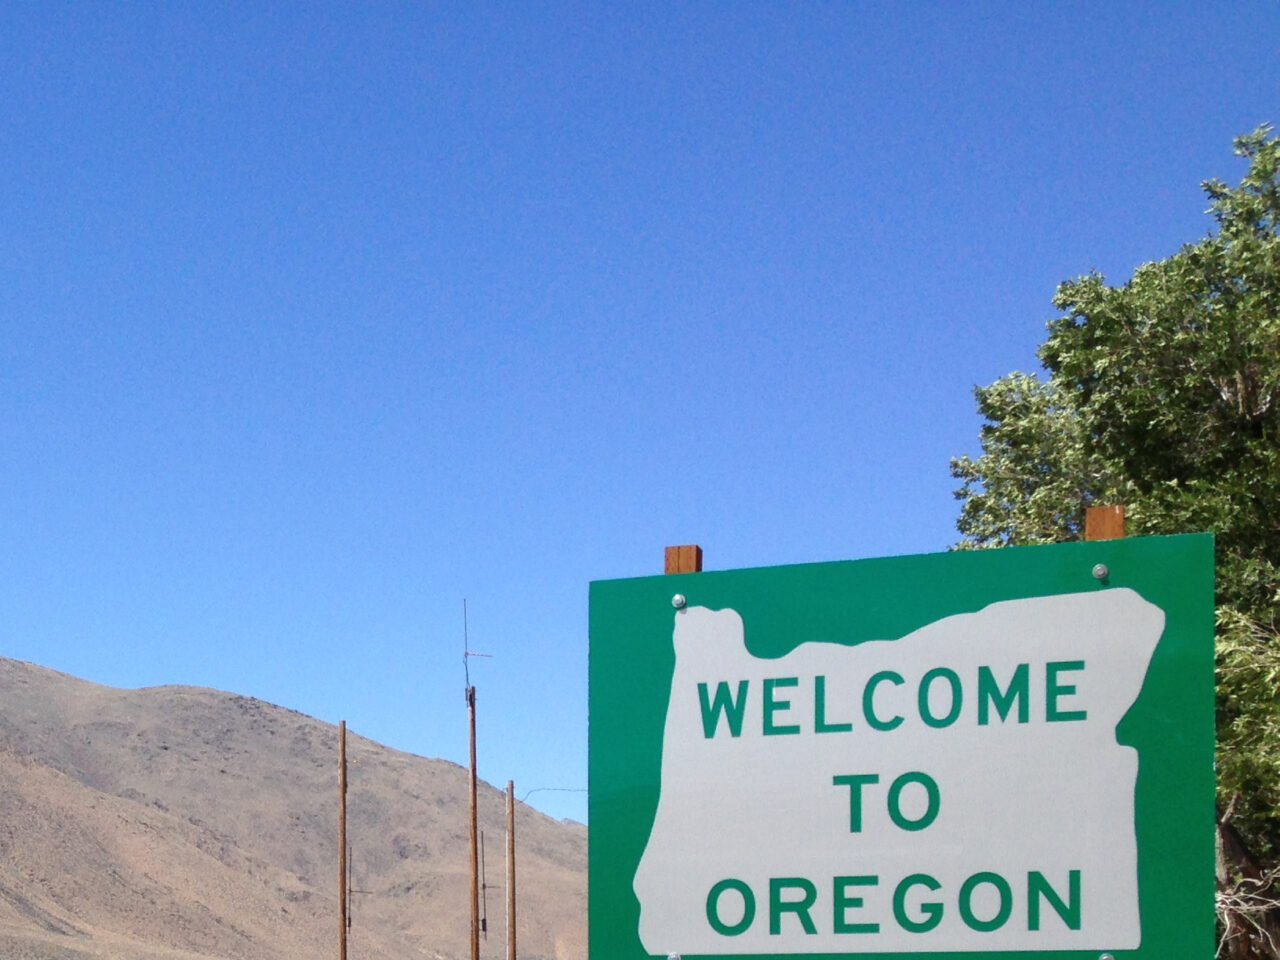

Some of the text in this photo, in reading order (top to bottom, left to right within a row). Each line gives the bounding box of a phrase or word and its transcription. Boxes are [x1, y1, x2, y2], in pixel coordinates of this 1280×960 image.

[696, 660, 1088, 739] WELCOME
[833, 771, 941, 833] TO
[705, 869, 1081, 937] OREGON
